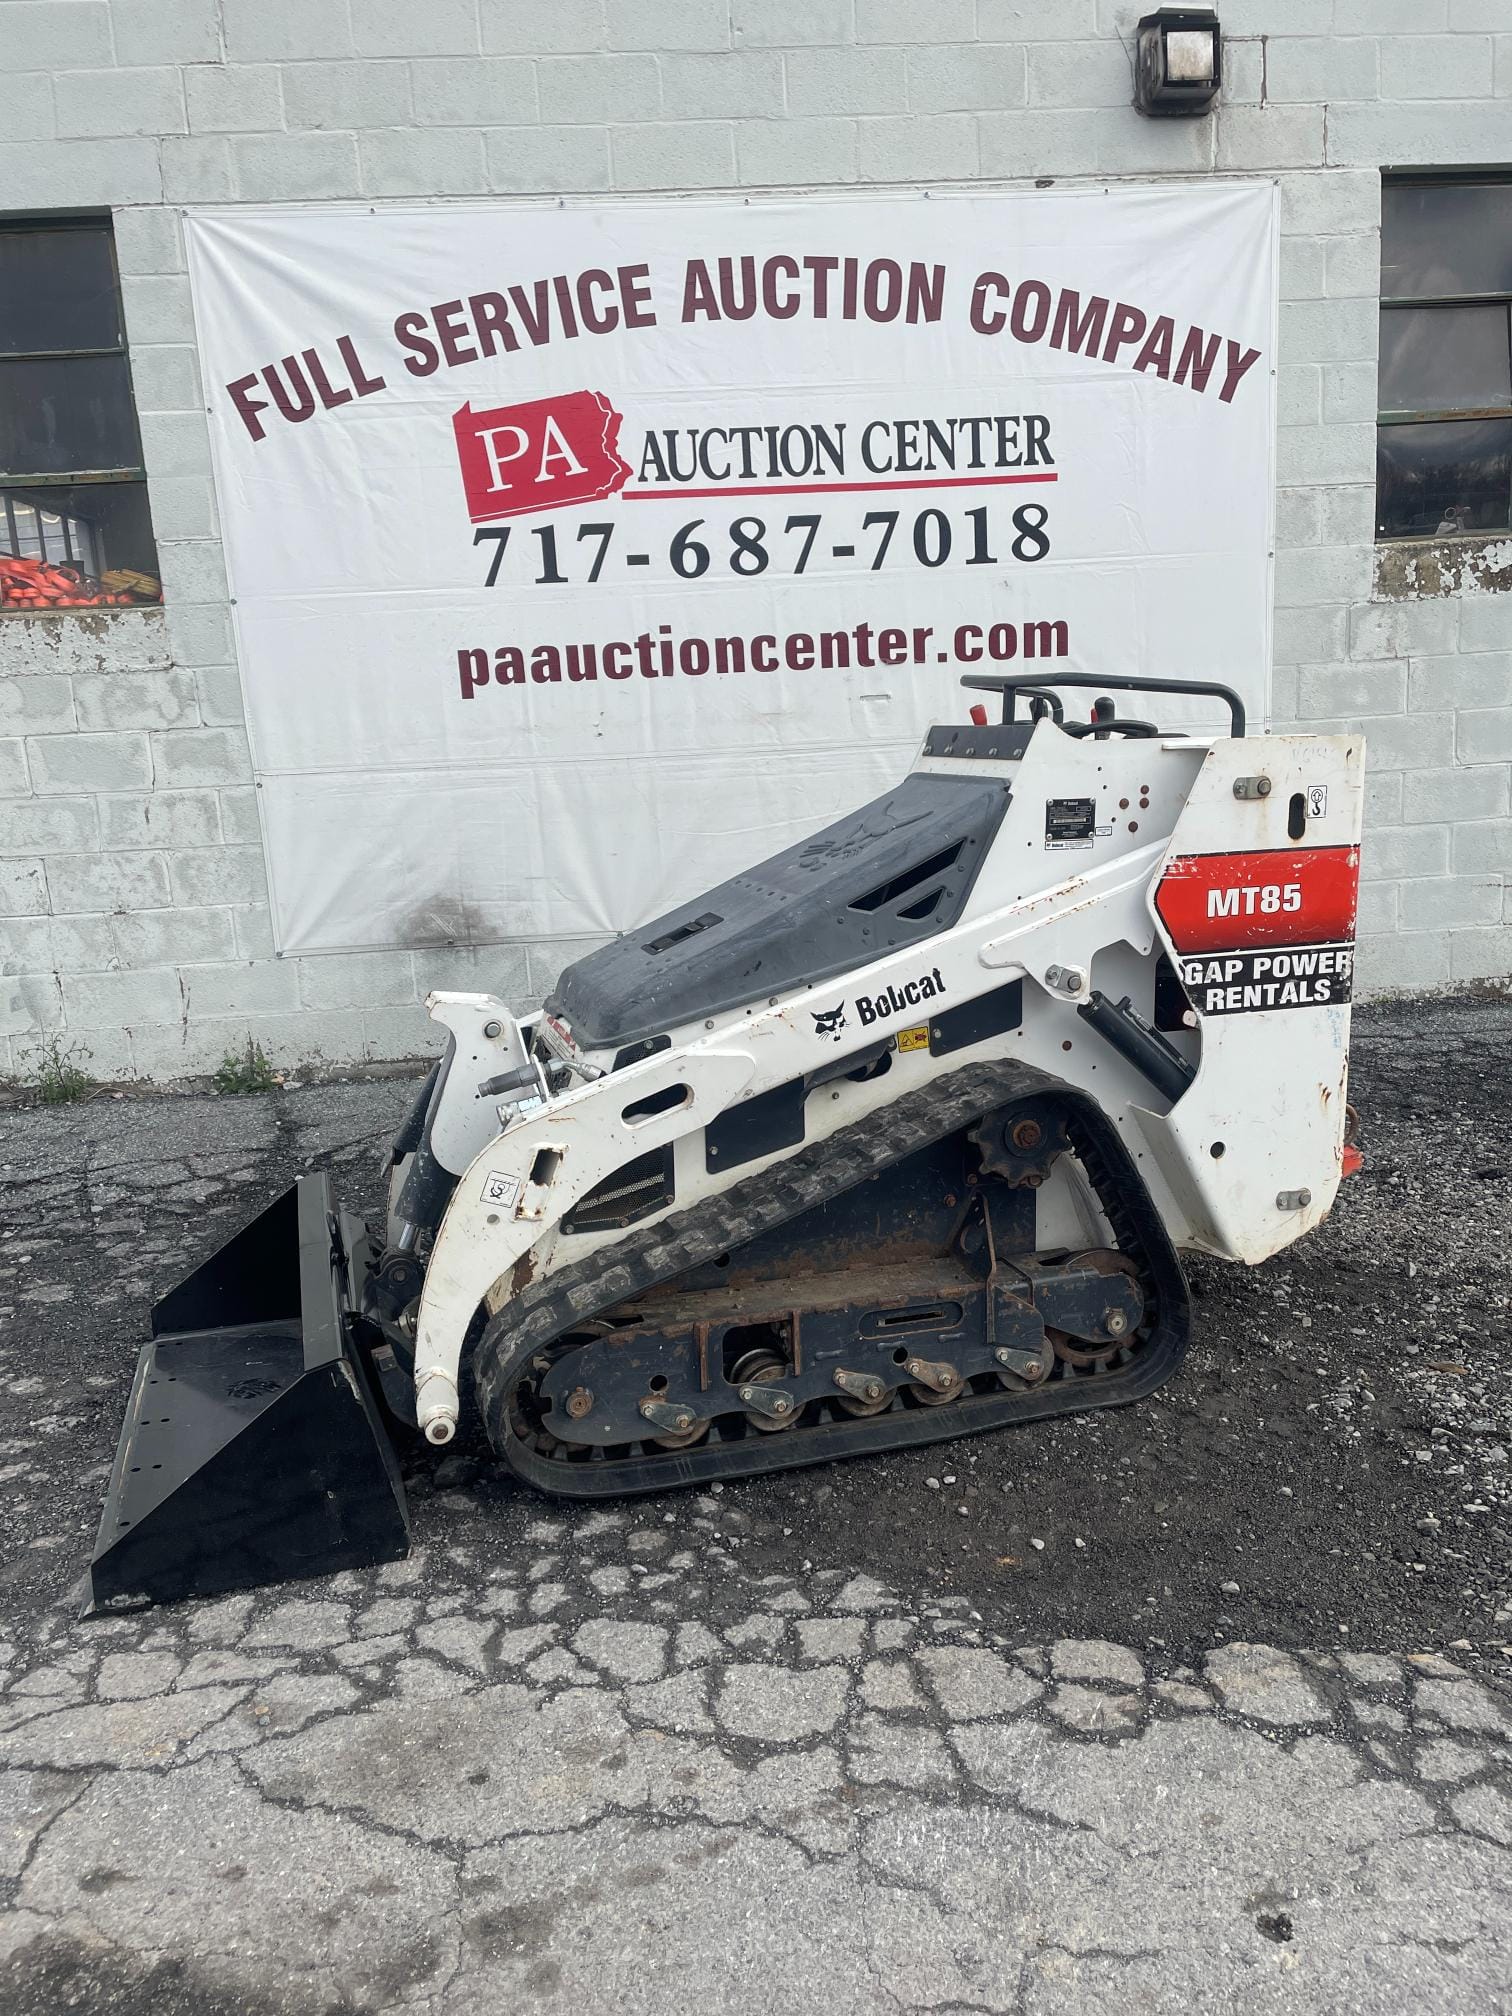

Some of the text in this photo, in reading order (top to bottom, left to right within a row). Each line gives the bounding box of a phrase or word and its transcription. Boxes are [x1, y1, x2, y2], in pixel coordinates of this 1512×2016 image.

[226, 255, 1262, 442] FULL SERVICE AUCTION COMPANY
[474, 415, 1054, 492] PA AUCTION CENTER
[472, 503, 1051, 587] 717-687-7018
[457, 621, 1069, 699] paauctioncenter.com
[1207, 883, 1302, 918] MT85
[855, 968, 946, 1026] Bobcat
[1185, 950, 1352, 986] GAP POWER
[1206, 979, 1331, 1011] RENTALS
